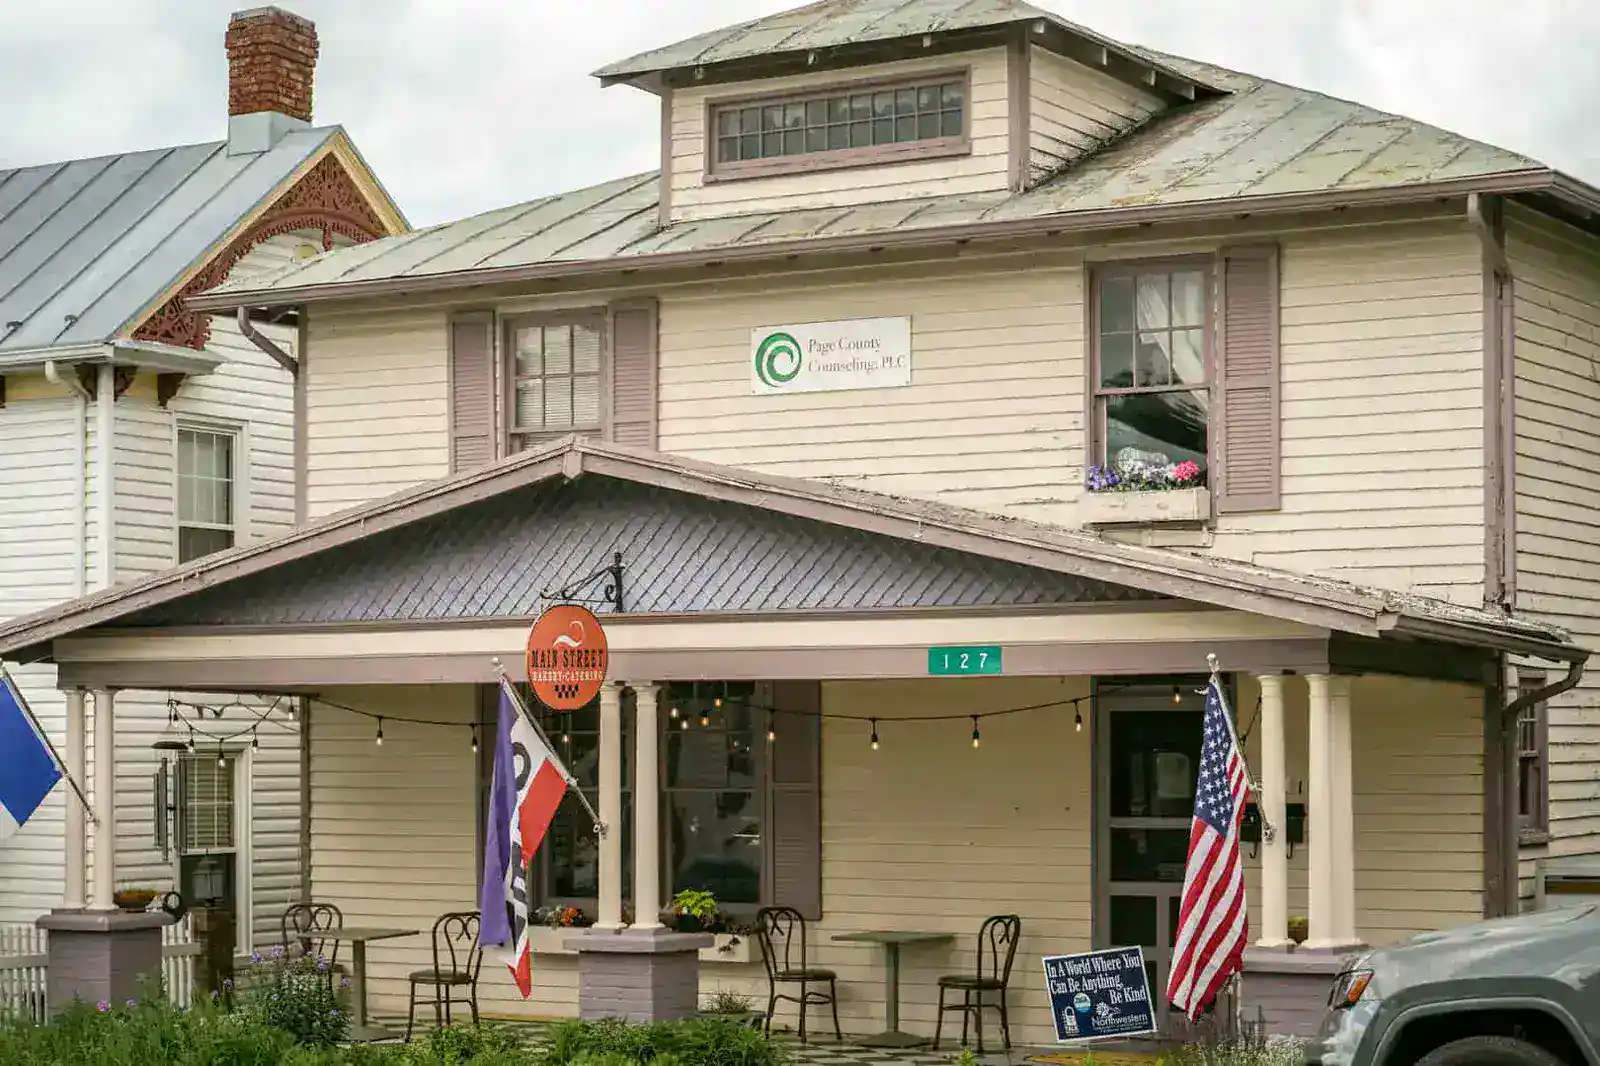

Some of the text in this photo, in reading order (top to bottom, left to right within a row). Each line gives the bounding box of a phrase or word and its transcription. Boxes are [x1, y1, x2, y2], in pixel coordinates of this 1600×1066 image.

[808, 336, 882, 356] Page County
[881, 353, 906, 369] PLC
[531, 649, 604, 668] MAIN STREET
[1047, 953, 1141, 978] In A World Where You
[1050, 980, 1068, 995] Can
[1068, 977, 1081, 992] Be
[1109, 990, 1122, 1005] Be
[1124, 986, 1147, 1002] Kind
[1092, 1013, 1148, 1027] Northwestern
